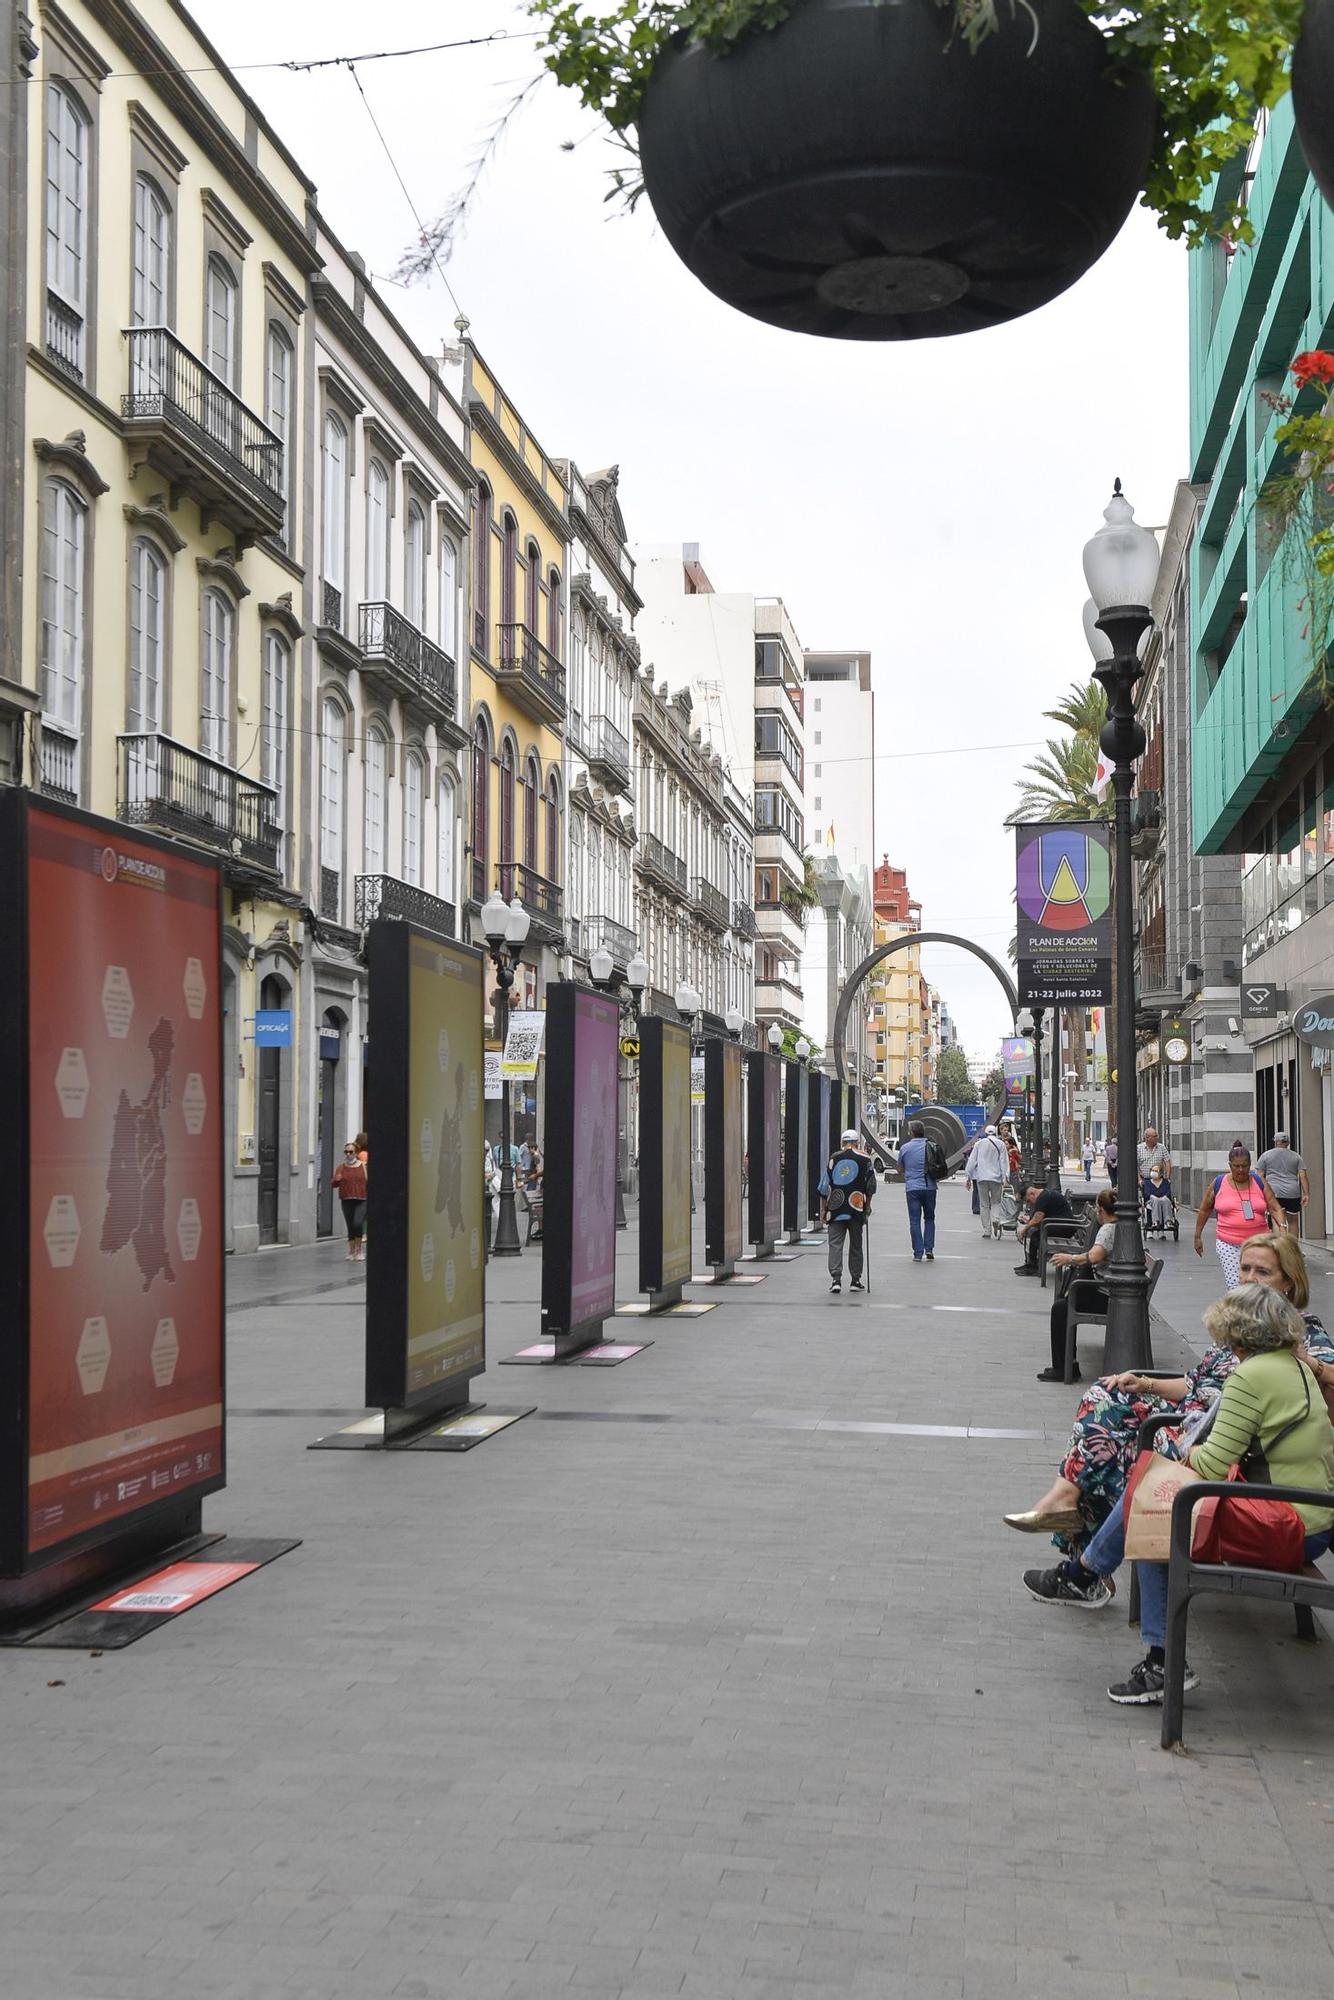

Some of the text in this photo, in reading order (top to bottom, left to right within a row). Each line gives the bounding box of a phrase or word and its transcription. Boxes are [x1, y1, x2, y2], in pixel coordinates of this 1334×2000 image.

[1029, 937, 1052, 946] PLAN
[1053, 937, 1065, 946] DE
[1027, 990, 1053, 998] 21-22
[1055, 990, 1077, 999] julio
[624, 1042, 640, 1054] IN
